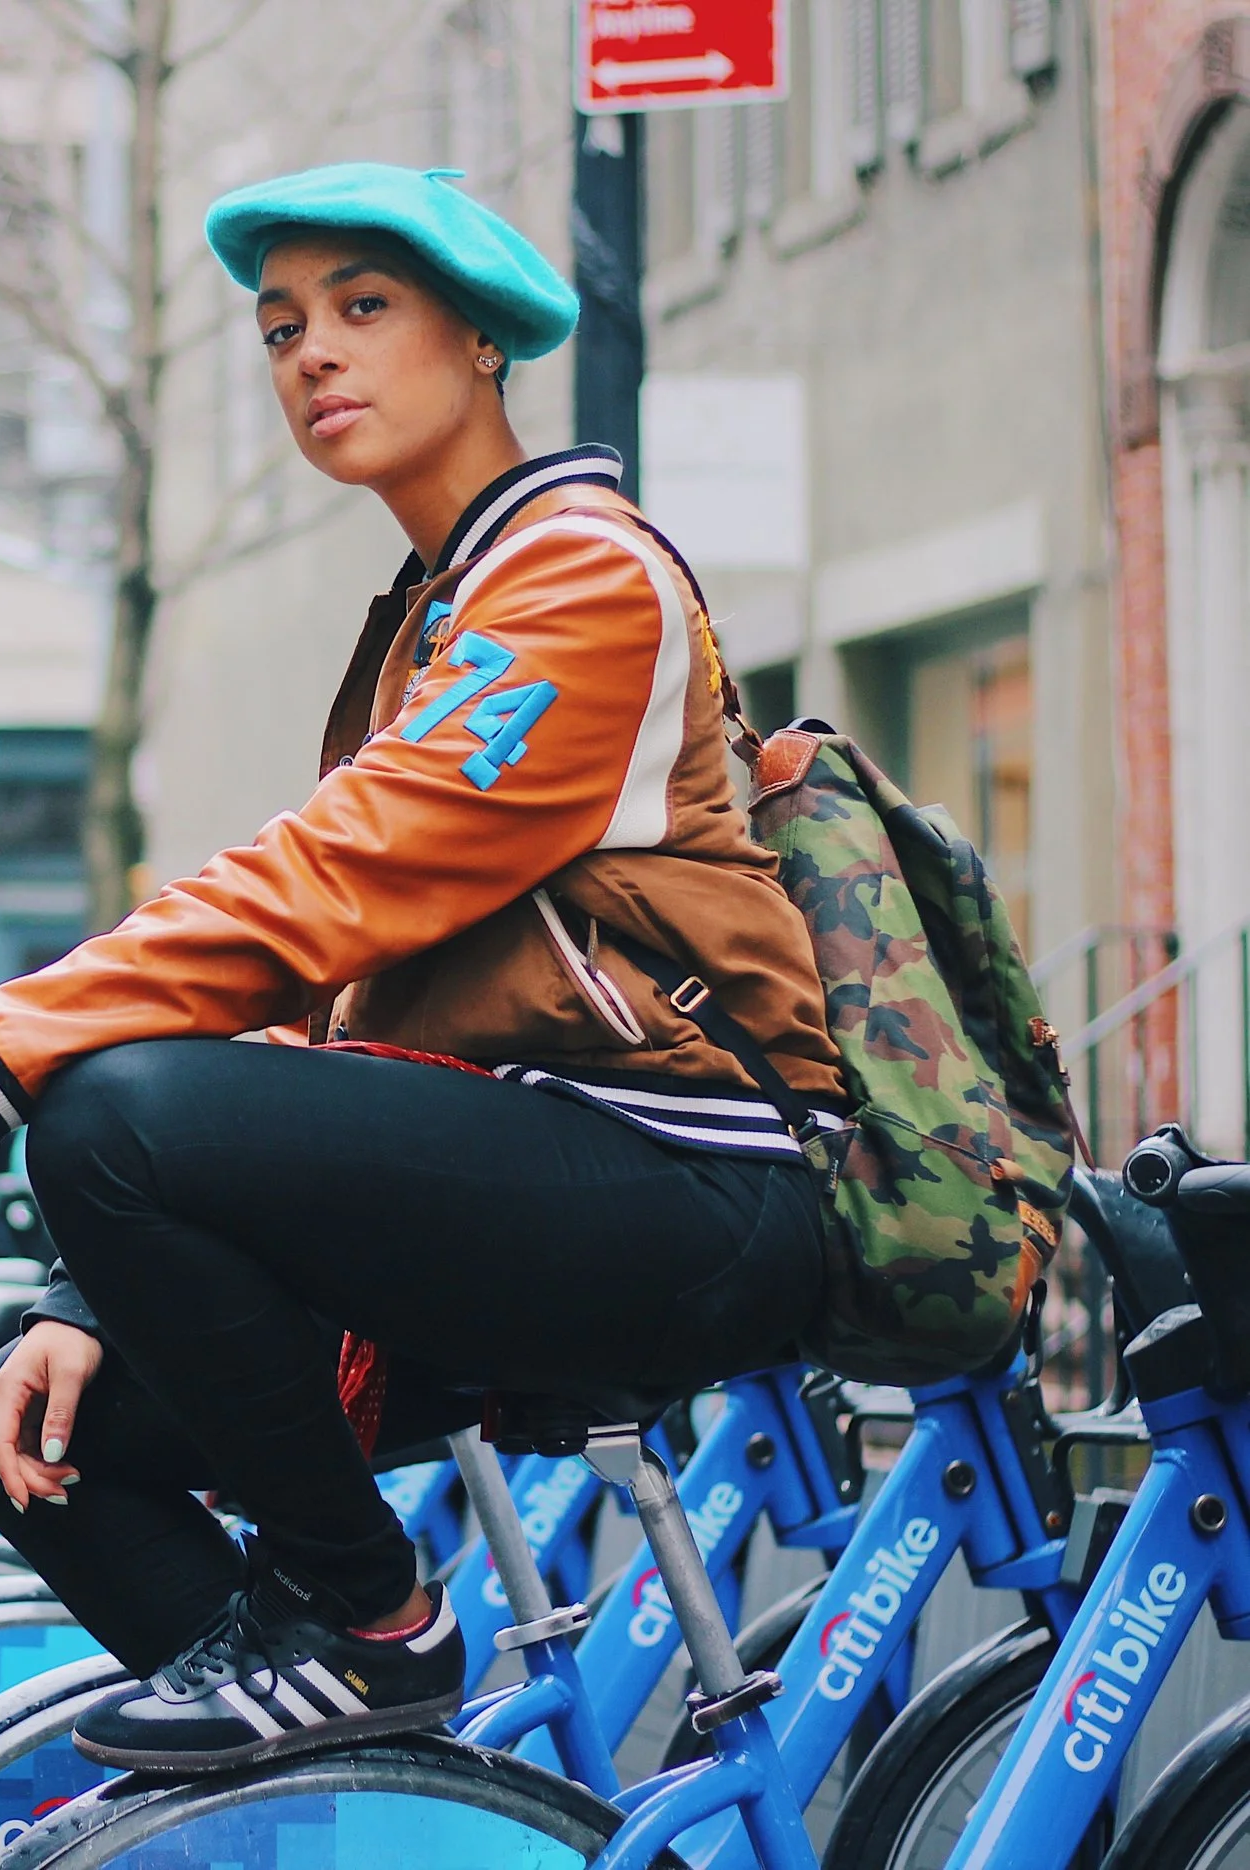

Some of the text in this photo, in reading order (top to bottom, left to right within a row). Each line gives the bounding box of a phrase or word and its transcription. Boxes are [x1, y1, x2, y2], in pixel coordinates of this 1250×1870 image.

[400, 630, 559, 791] 74
[273, 1567, 312, 1601] adidas
[817, 1516, 940, 1701] citi bike
[344, 1669, 369, 1696] SAMBA
[1063, 1562, 1186, 1773] citi bike
